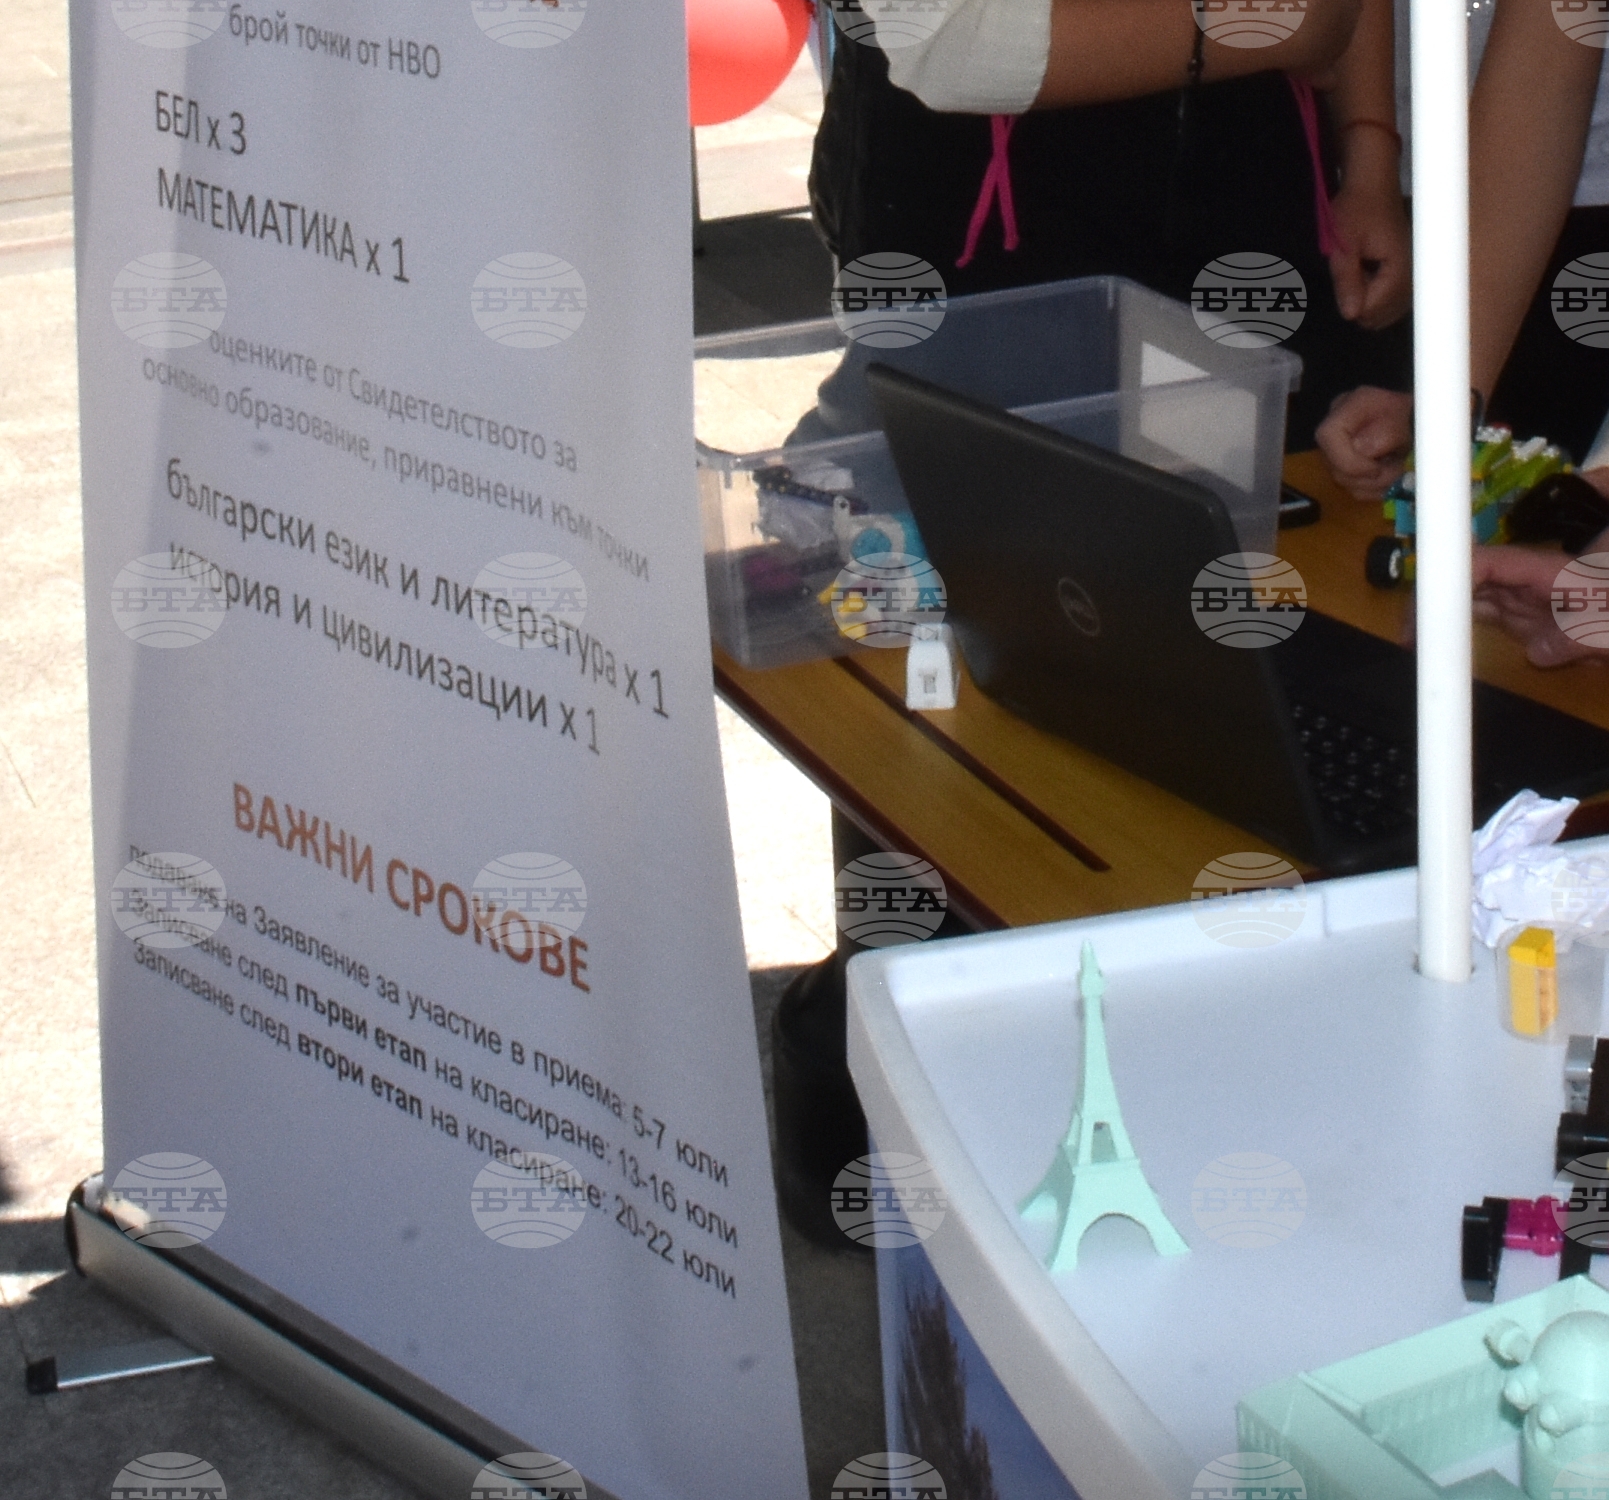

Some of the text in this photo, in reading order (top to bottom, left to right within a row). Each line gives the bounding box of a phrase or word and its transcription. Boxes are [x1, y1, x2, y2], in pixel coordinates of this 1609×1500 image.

[155, 90, 201, 144] БЕЛ
[229, 112, 248, 157] 3
[229, 3, 441, 81] брой точки от НВО
[157, 167, 358, 270] МАТЕМАТИКА
[391, 237, 410, 284] 1
[143, 354, 220, 408] основно
[224, 386, 377, 471] образование,
[383, 443, 544, 521] приравнени
[209, 328, 578, 474] оценките от Свидетелството за
[167, 457, 316, 554] български
[325, 529, 390, 589] език
[400, 562, 420, 601] и
[431, 575, 617, 689] литература
[651, 668, 670, 720] 1
[169, 542, 281, 619] история
[293, 592, 312, 630] и
[322, 603, 549, 728] цивилизации
[586, 706, 601, 756] 1
[232, 783, 592, 993] ВАЖНИ СРОКОВЕ
[133, 937, 736, 1299] Записване след втори етап на класиране: 20-22 юли
[225, 899, 248, 926] на
[252, 904, 370, 989] Заявление
[376, 973, 400, 1005] за
[405, 989, 503, 1056] участие
[510, 1039, 526, 1068] в
[632, 1102, 667, 1150] 5-7
[675, 1137, 729, 1189] юли
[237, 954, 289, 999] след
[295, 982, 368, 1039] първи
[374, 1025, 428, 1073] етап
[434, 1056, 464, 1090] на
[470, 1074, 612, 1165] класиране:
[617, 1147, 678, 1213] 13-16
[684, 1196, 739, 1250] юли
